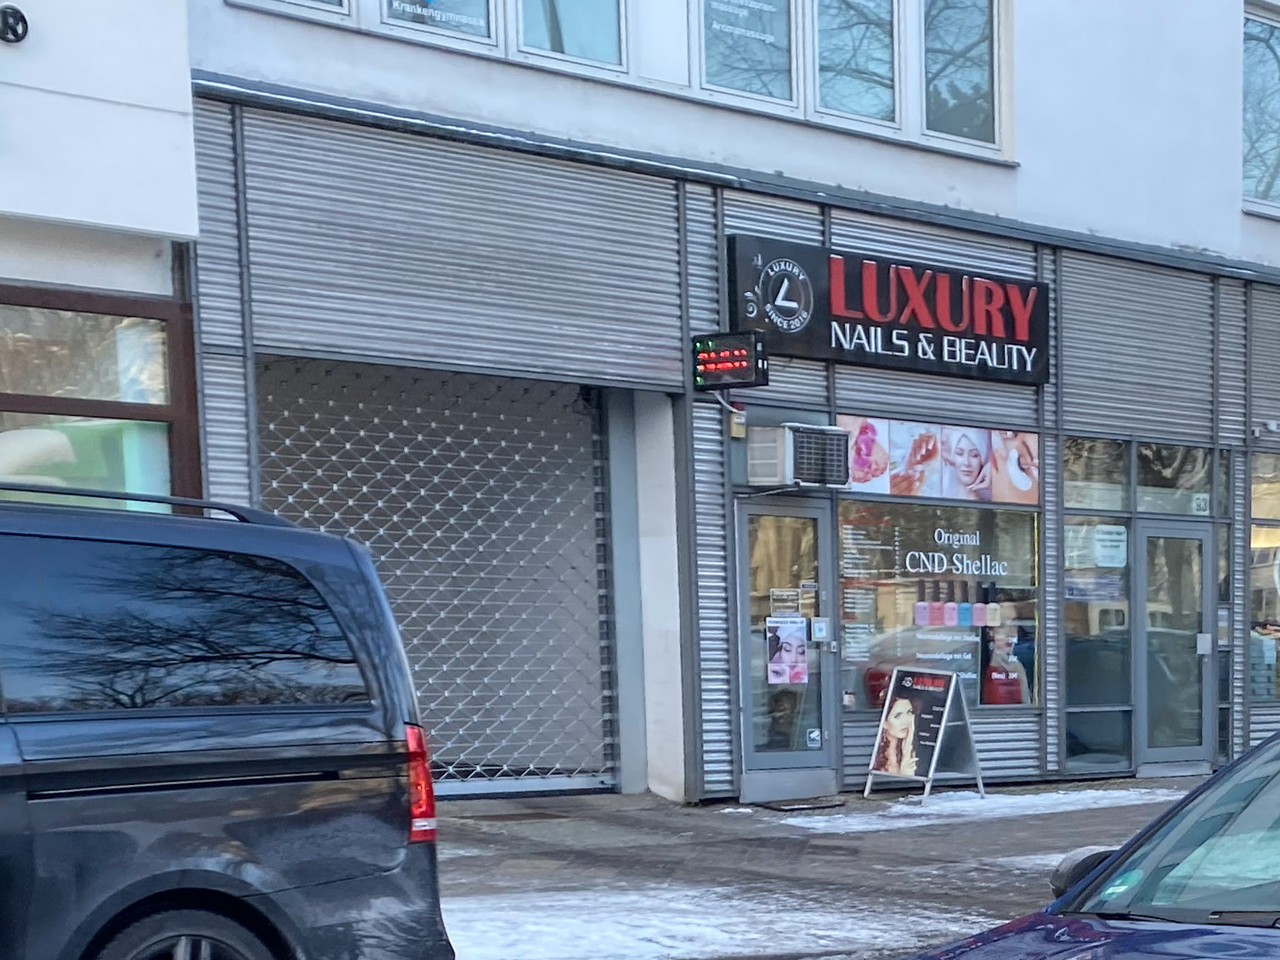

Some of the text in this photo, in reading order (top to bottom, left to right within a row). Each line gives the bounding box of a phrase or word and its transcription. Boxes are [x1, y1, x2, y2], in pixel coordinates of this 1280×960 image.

[767, 261, 806, 280] LUXURY
[829, 253, 1038, 342] LUXURY
[765, 303, 789, 329] SINCE
[830, 321, 1037, 372] NAILS & BEAUTY
[934, 528, 980, 549] Original
[905, 551, 1008, 576] CND Shellac
